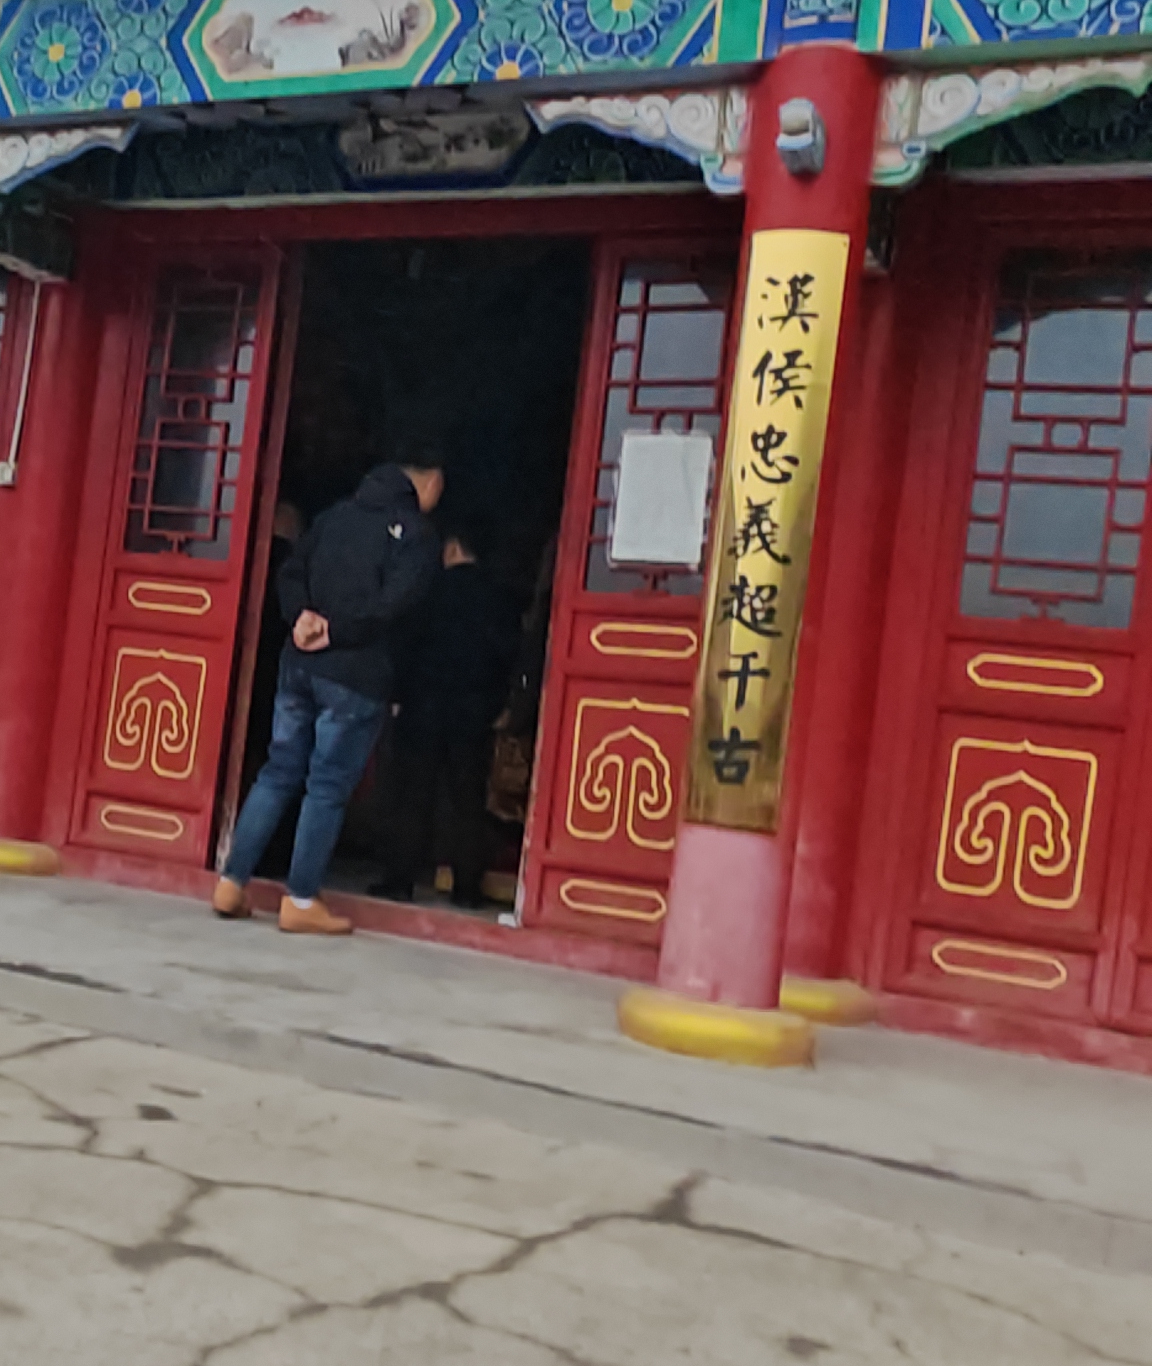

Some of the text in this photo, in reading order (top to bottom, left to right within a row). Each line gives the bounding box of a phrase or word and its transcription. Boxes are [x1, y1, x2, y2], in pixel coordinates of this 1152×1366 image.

[707, 272, 819, 787] 漢侯忠義超千古
